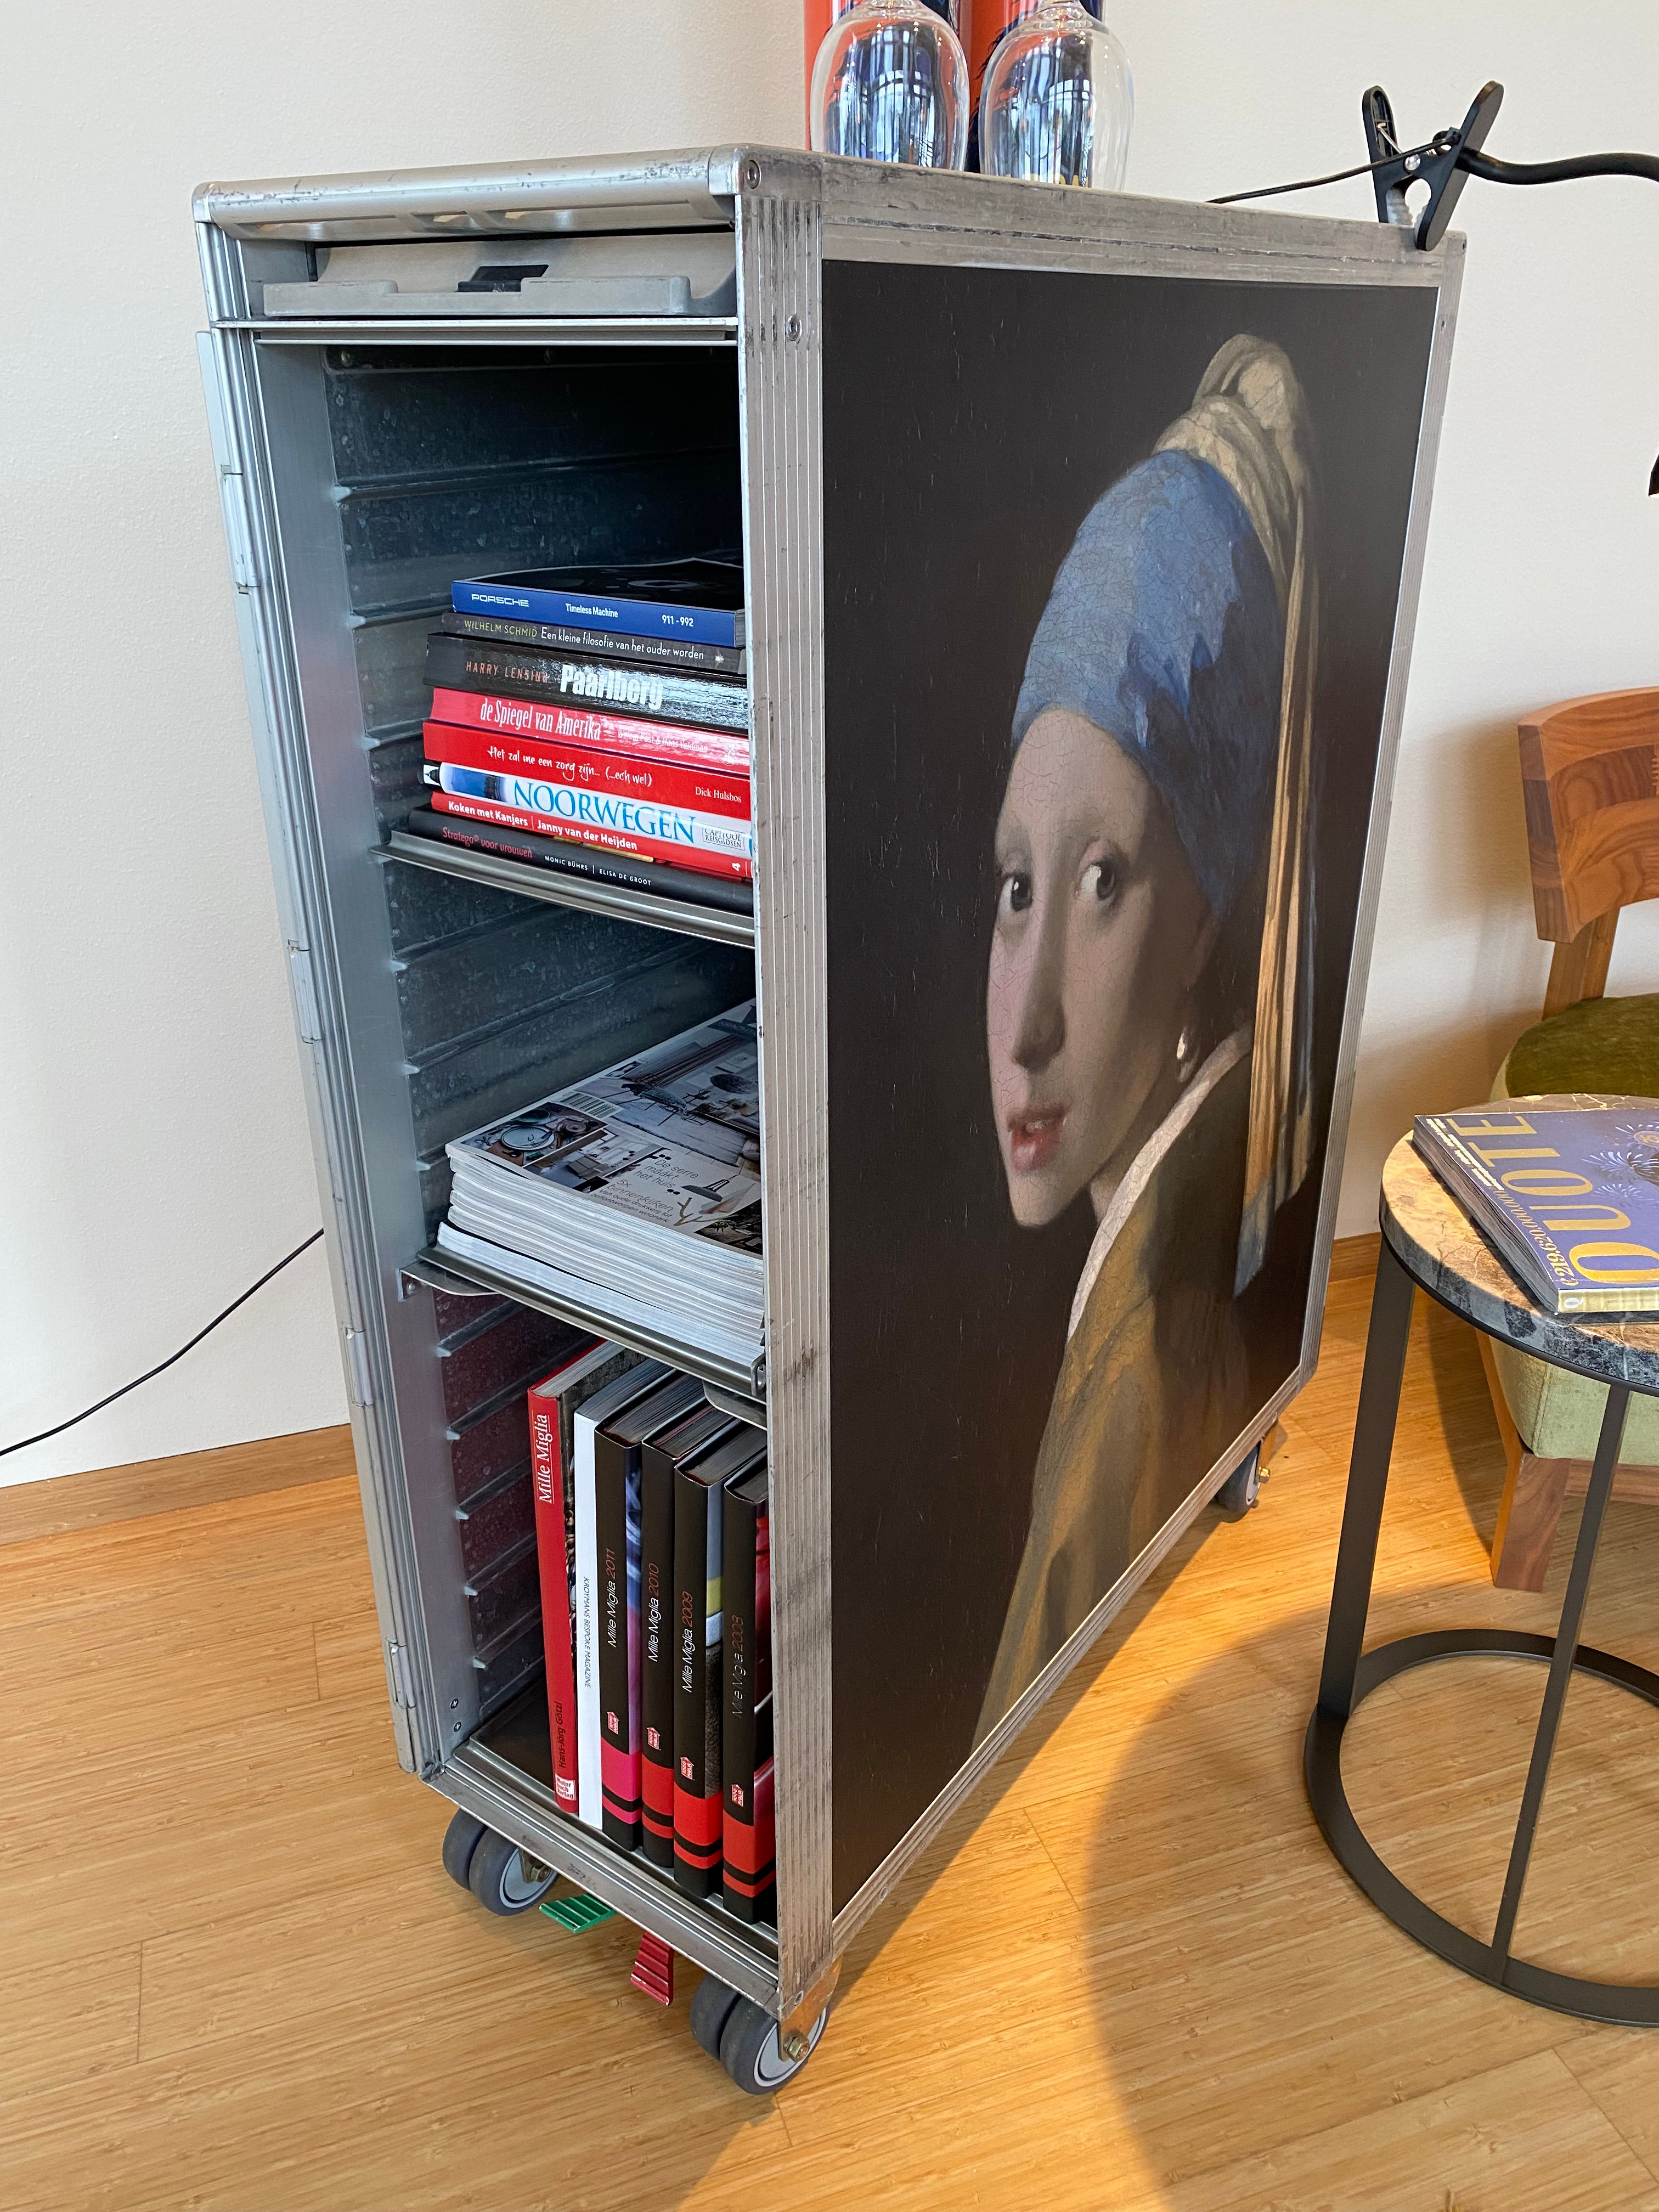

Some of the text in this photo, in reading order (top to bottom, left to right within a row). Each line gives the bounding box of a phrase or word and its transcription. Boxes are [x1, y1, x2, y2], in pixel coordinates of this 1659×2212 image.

[471, 593, 529, 607] PORSCHE
[565, 603, 618, 618] Timeless Machine
[464, 620, 537, 637] WILHELM SCHMID
[662, 614, 674, 625] 911
[680, 617, 694, 627] 992
[541, 627, 704, 659] Een kleine filosofie van het ouder worden
[466, 661, 499, 675] HARRY
[560, 664, 663, 711] Paarlberg
[480, 698, 601, 741] de Spiegel van Amerika
[487, 746, 505, 760] Het
[508, 750, 520, 762] zal
[523, 755, 535, 764] me
[538, 758, 553, 768] een
[555, 761, 575, 781] zorg
[632, 772, 652, 787] wel)
[695, 786, 742, 803] Dick Hulsbos
[448, 801, 637, 850] Koken met Kanjers Janny van der Heijden
[514, 779, 696, 844] NOORWEGEN
[481, 839, 499, 851] voor
[500, 845, 533, 859] vrouwen
[706, 834, 742, 848] REISGIDSEN
[545, 855, 565, 865] MONIC
[567, 857, 588, 871] BÜHRS
[599, 868, 617, 878] ELISA
[629, 874, 651, 885] GROOT
[633, 1170, 675, 1188] het huis
[654, 1159, 699, 1178] De serre
[534, 1414, 555, 1504] Mille Miglia
[606, 1548, 618, 1648] Mille Miglia 2011
[648, 1563, 662, 1662] Mille Miglia 2010
[682, 1591, 696, 1693] Mille Miglia 2009
